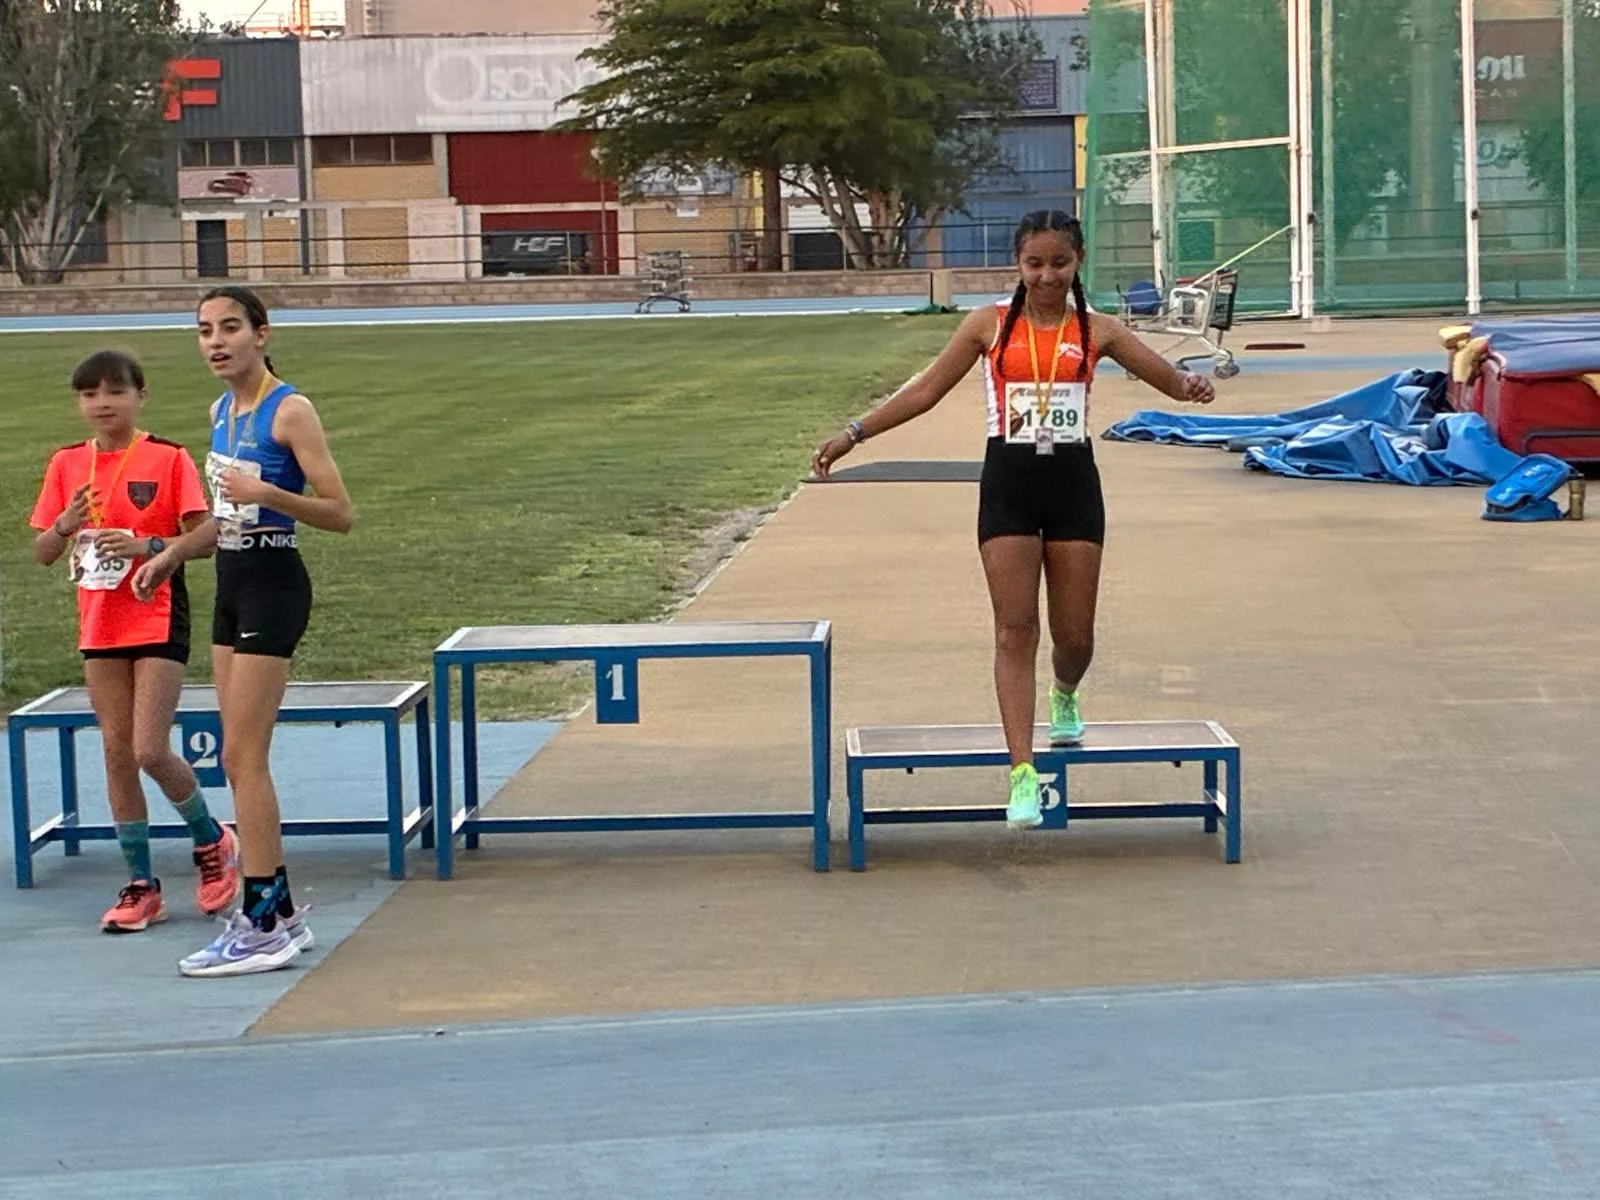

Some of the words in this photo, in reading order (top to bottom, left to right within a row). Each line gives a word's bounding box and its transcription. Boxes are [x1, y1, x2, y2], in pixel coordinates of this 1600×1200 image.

[1021, 408, 1079, 428] 1789
[606, 664, 626, 701] 1
[190, 731, 218, 768] 2
